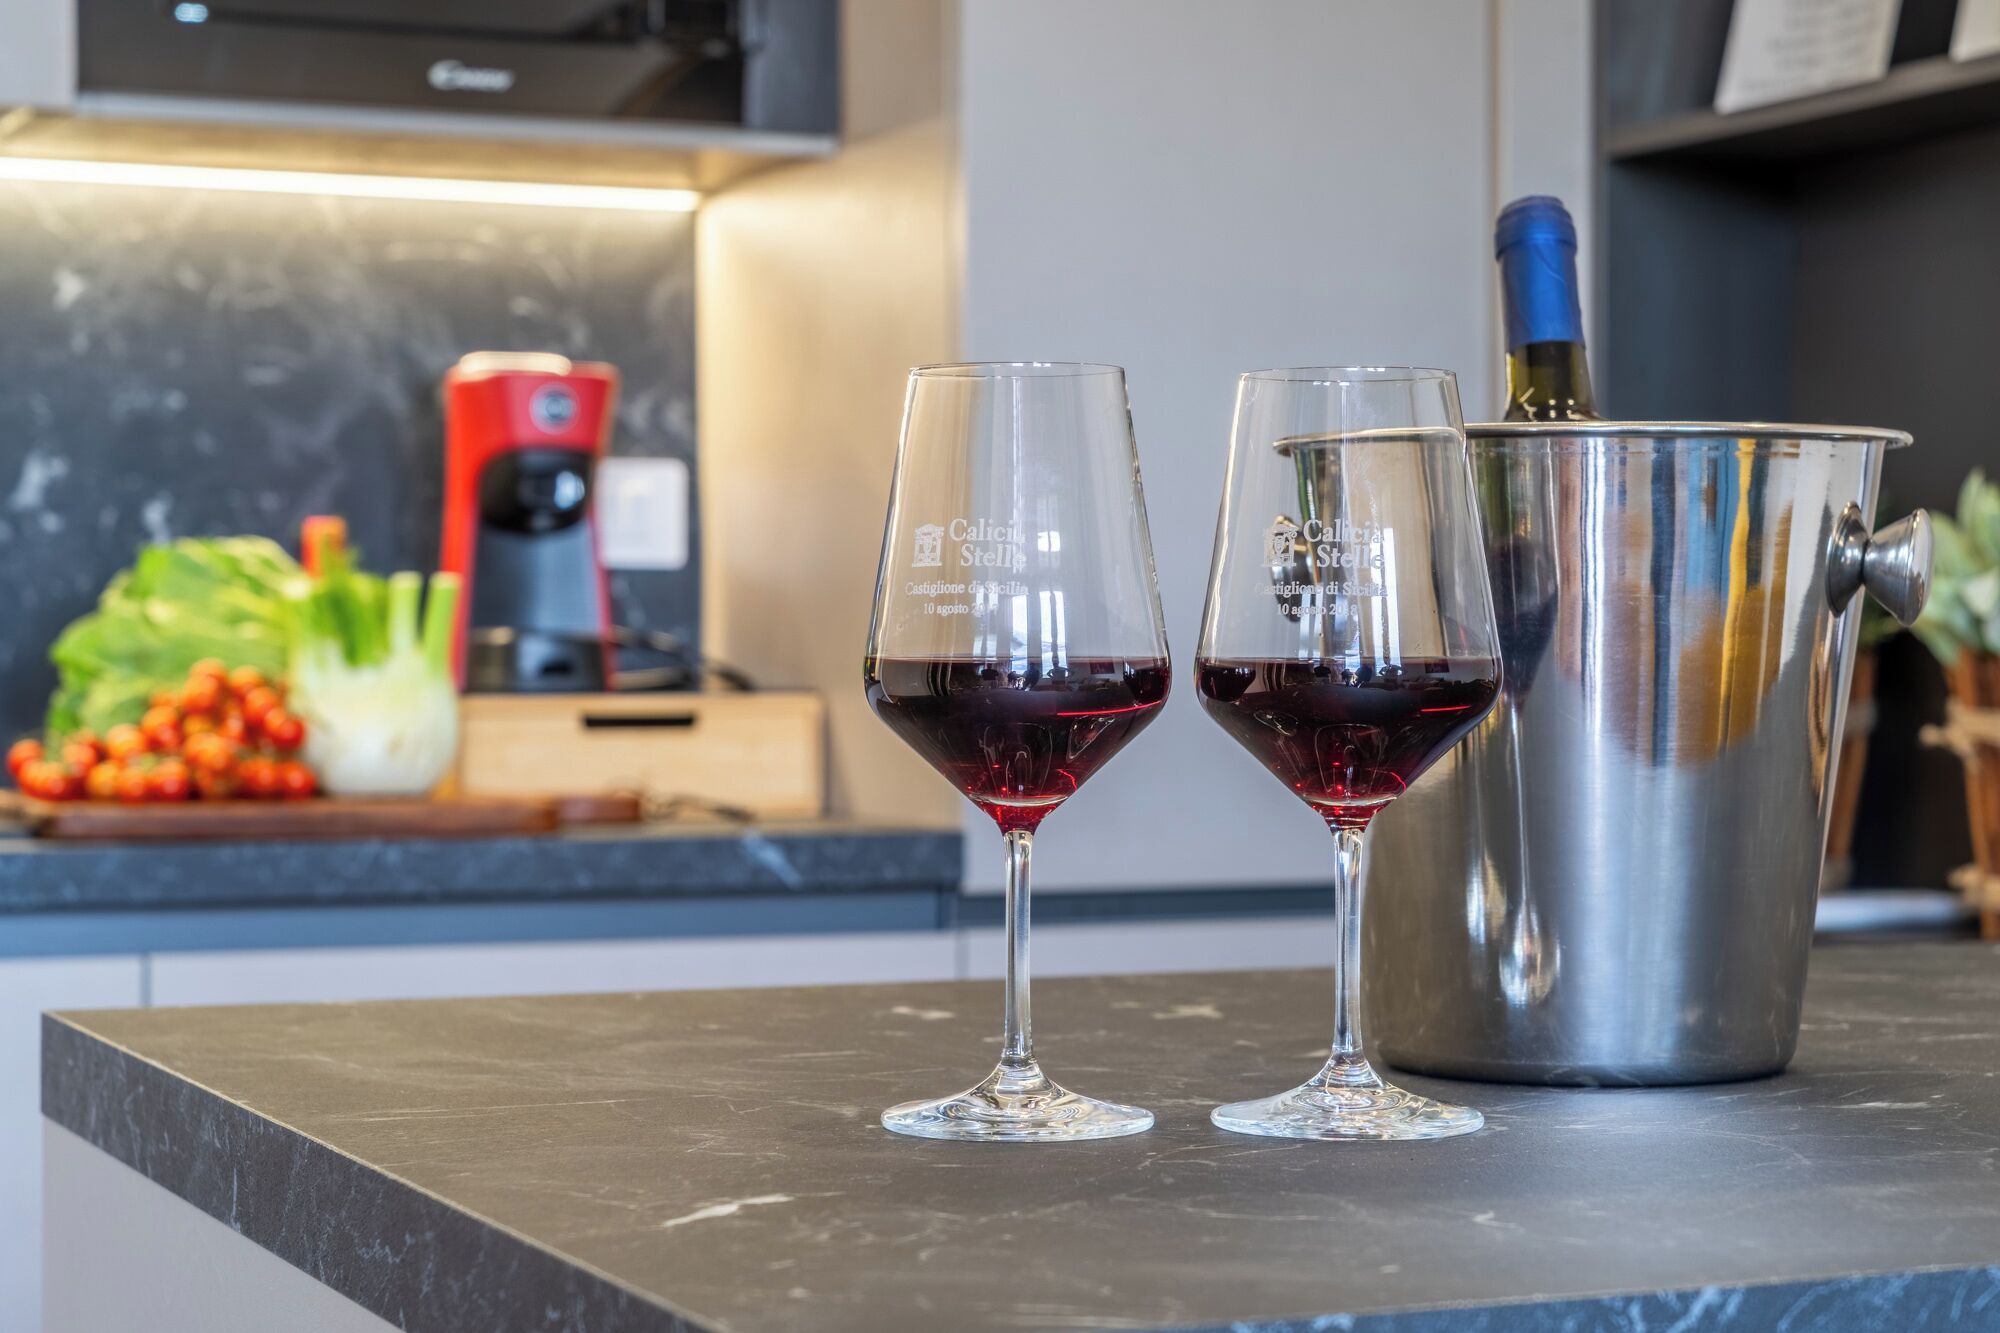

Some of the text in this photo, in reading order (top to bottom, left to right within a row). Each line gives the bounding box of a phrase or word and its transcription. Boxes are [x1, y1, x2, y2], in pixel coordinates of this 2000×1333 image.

[949, 518, 1014, 541] Calici
[1303, 519, 1371, 543] Calici
[961, 543, 1027, 568] Stelle
[1316, 544, 1385, 569] Stelle
[905, 580, 965, 598] Castiglione
[1254, 581, 1322, 598] Castiglione
[1325, 581, 1339, 595] di
[923, 602, 935, 615] 10
[936, 603, 969, 617] agosto
[1277, 603, 1290, 615] 10
[1291, 604, 1327, 618] agosto
